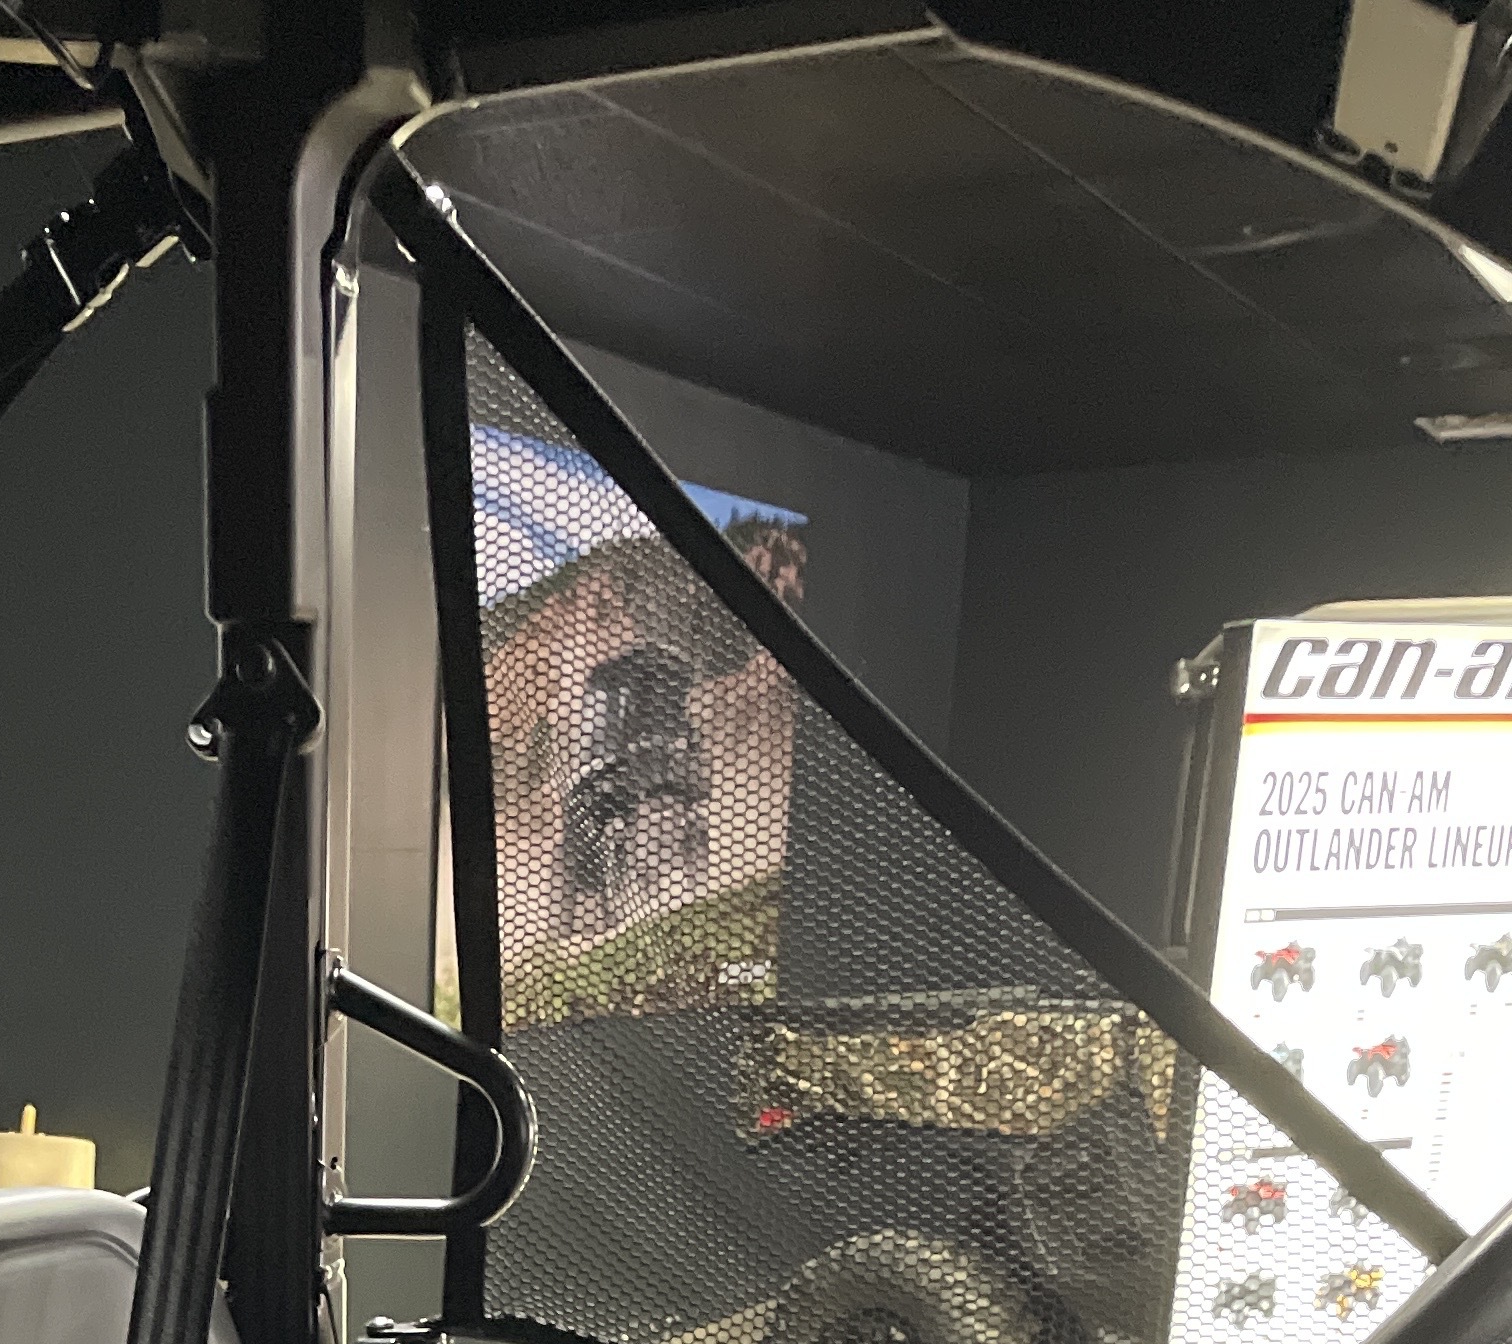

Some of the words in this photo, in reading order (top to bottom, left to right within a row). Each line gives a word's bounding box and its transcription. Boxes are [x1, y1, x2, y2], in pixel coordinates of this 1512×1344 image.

[1260, 636, 1512, 700] can-a
[1259, 771, 1329, 816] 2025
[1341, 771, 1451, 815] CAN-AM
[1254, 827, 1417, 873] OUTLANDER
